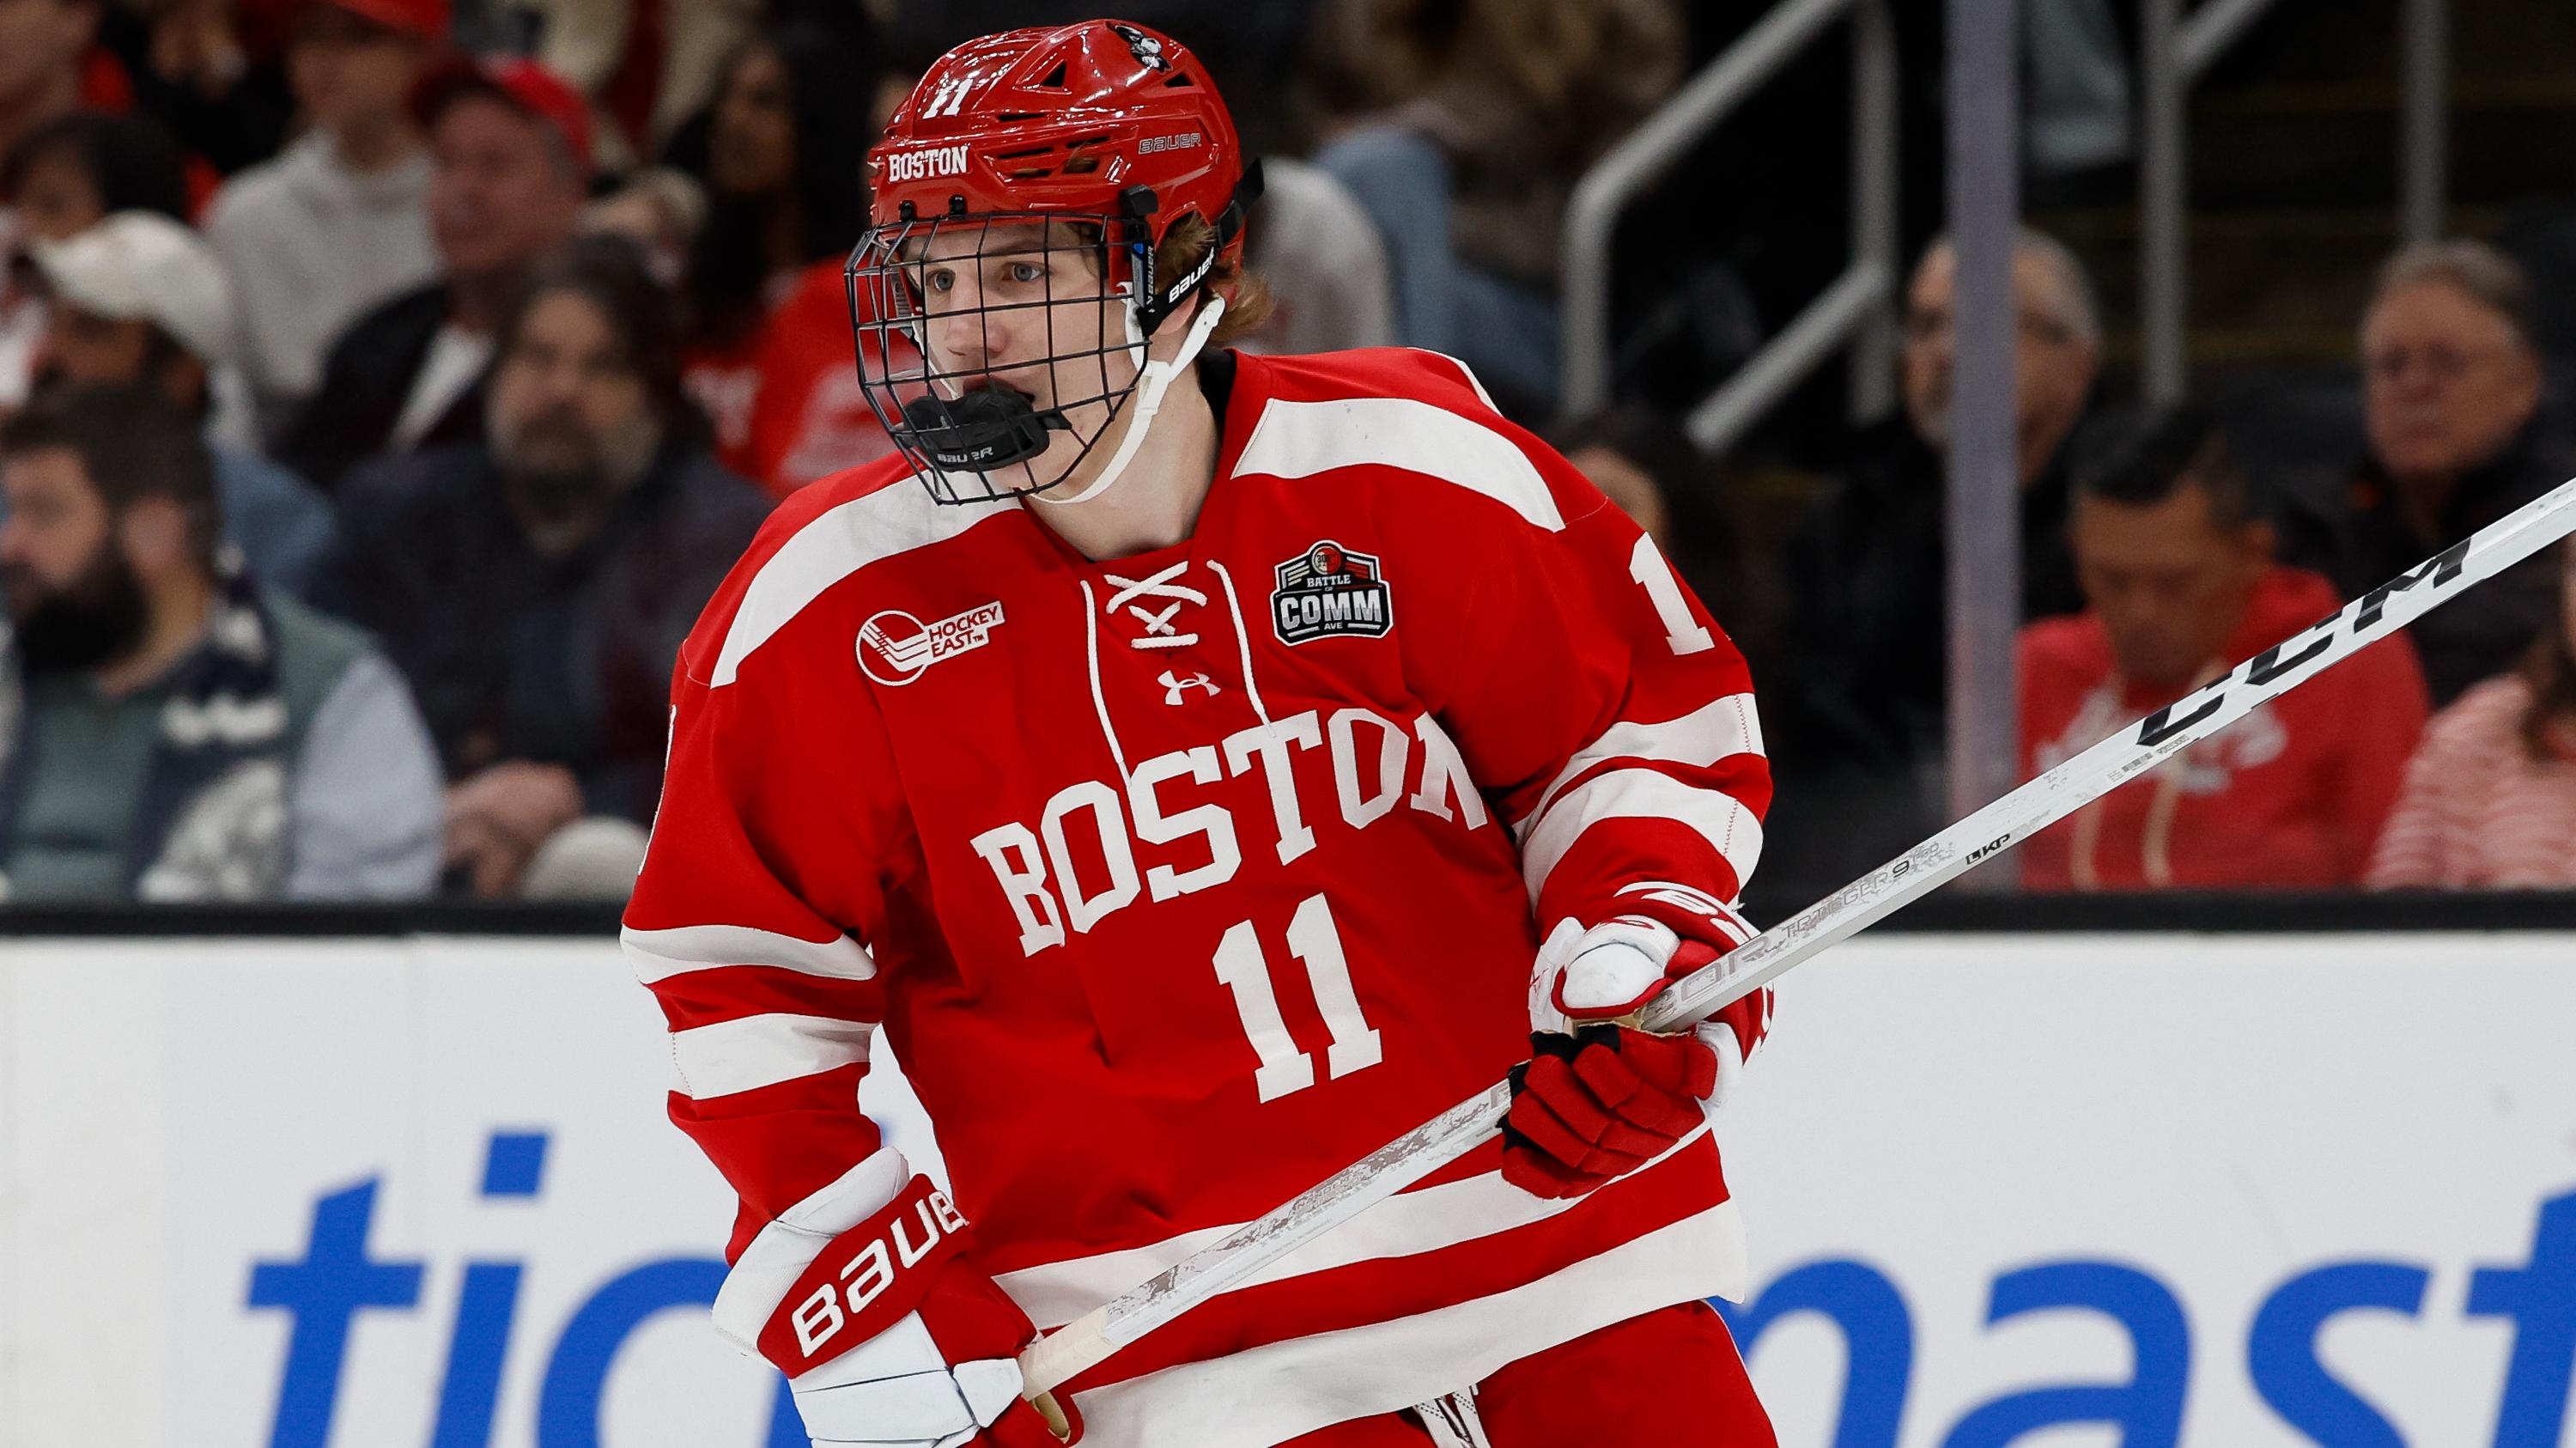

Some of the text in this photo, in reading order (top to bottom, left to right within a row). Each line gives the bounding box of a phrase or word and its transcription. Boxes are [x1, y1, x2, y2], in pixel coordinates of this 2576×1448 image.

[888, 146, 969, 182] BOSTON
[1138, 133, 1202, 155] BAUER
[1169, 246, 1214, 304] BAUER
[1306, 574, 1352, 588] BATTLE
[928, 605, 998, 642] HOCKEY
[1279, 589, 1382, 638] COMM
[1323, 622, 1344, 630] AVE
[2135, 536, 2472, 746] CCM
[969, 708, 1488, 958] BOSTON
[1892, 860, 1911, 878] 9
[1212, 892, 1383, 1104] 11
[791, 1189, 970, 1359] BAUE
